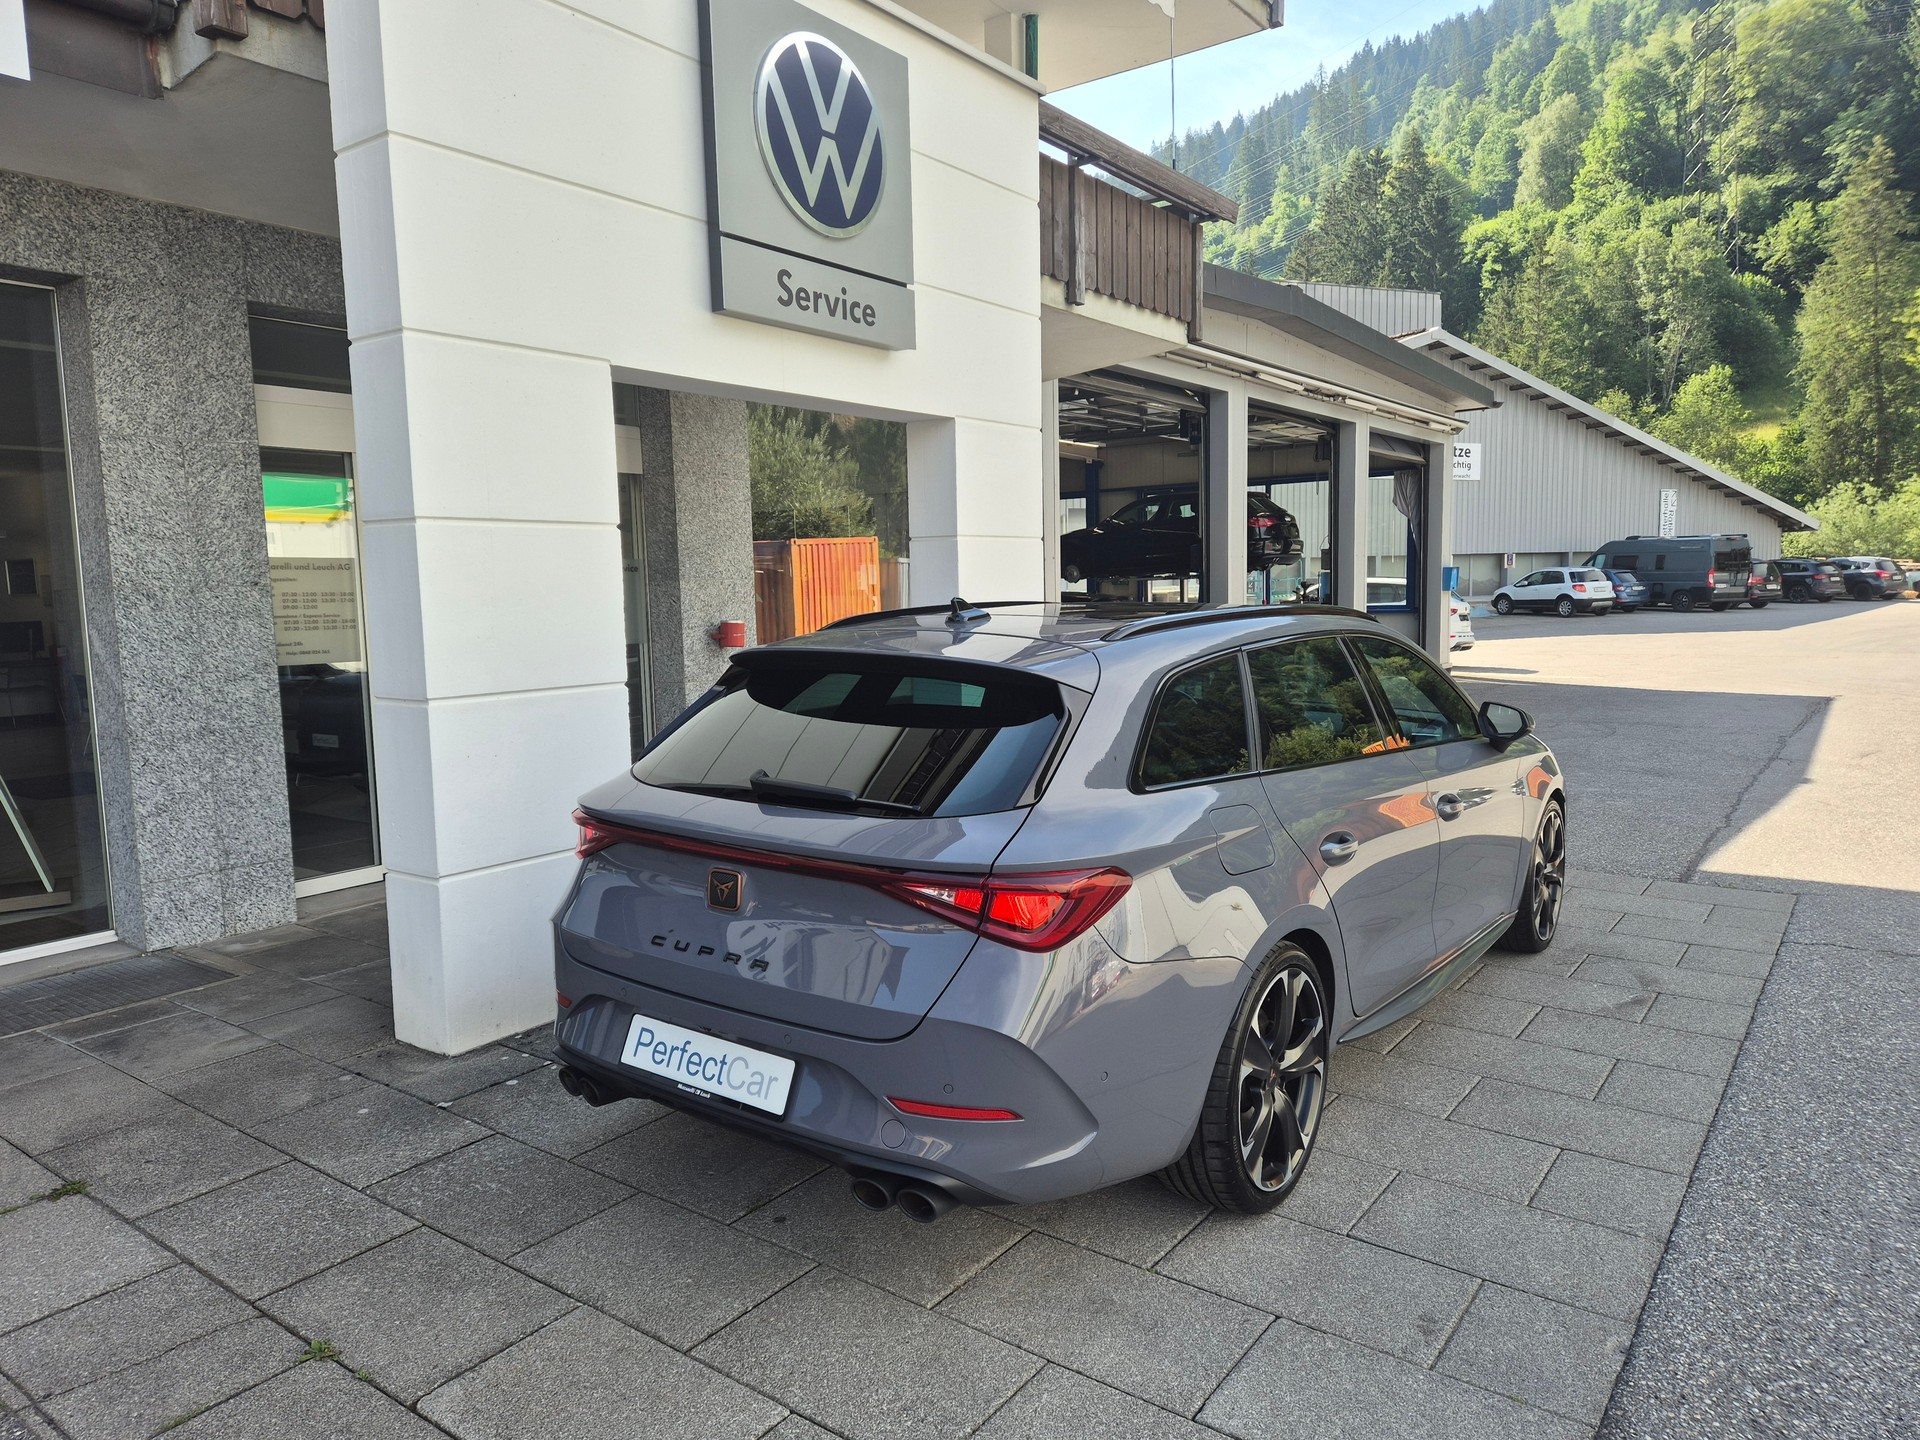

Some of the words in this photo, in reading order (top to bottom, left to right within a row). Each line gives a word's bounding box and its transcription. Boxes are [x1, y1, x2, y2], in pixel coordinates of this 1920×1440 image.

[776, 268, 877, 327] Service
[650, 933, 770, 972] CUPRA
[632, 1026, 779, 1100] PerfectCar
